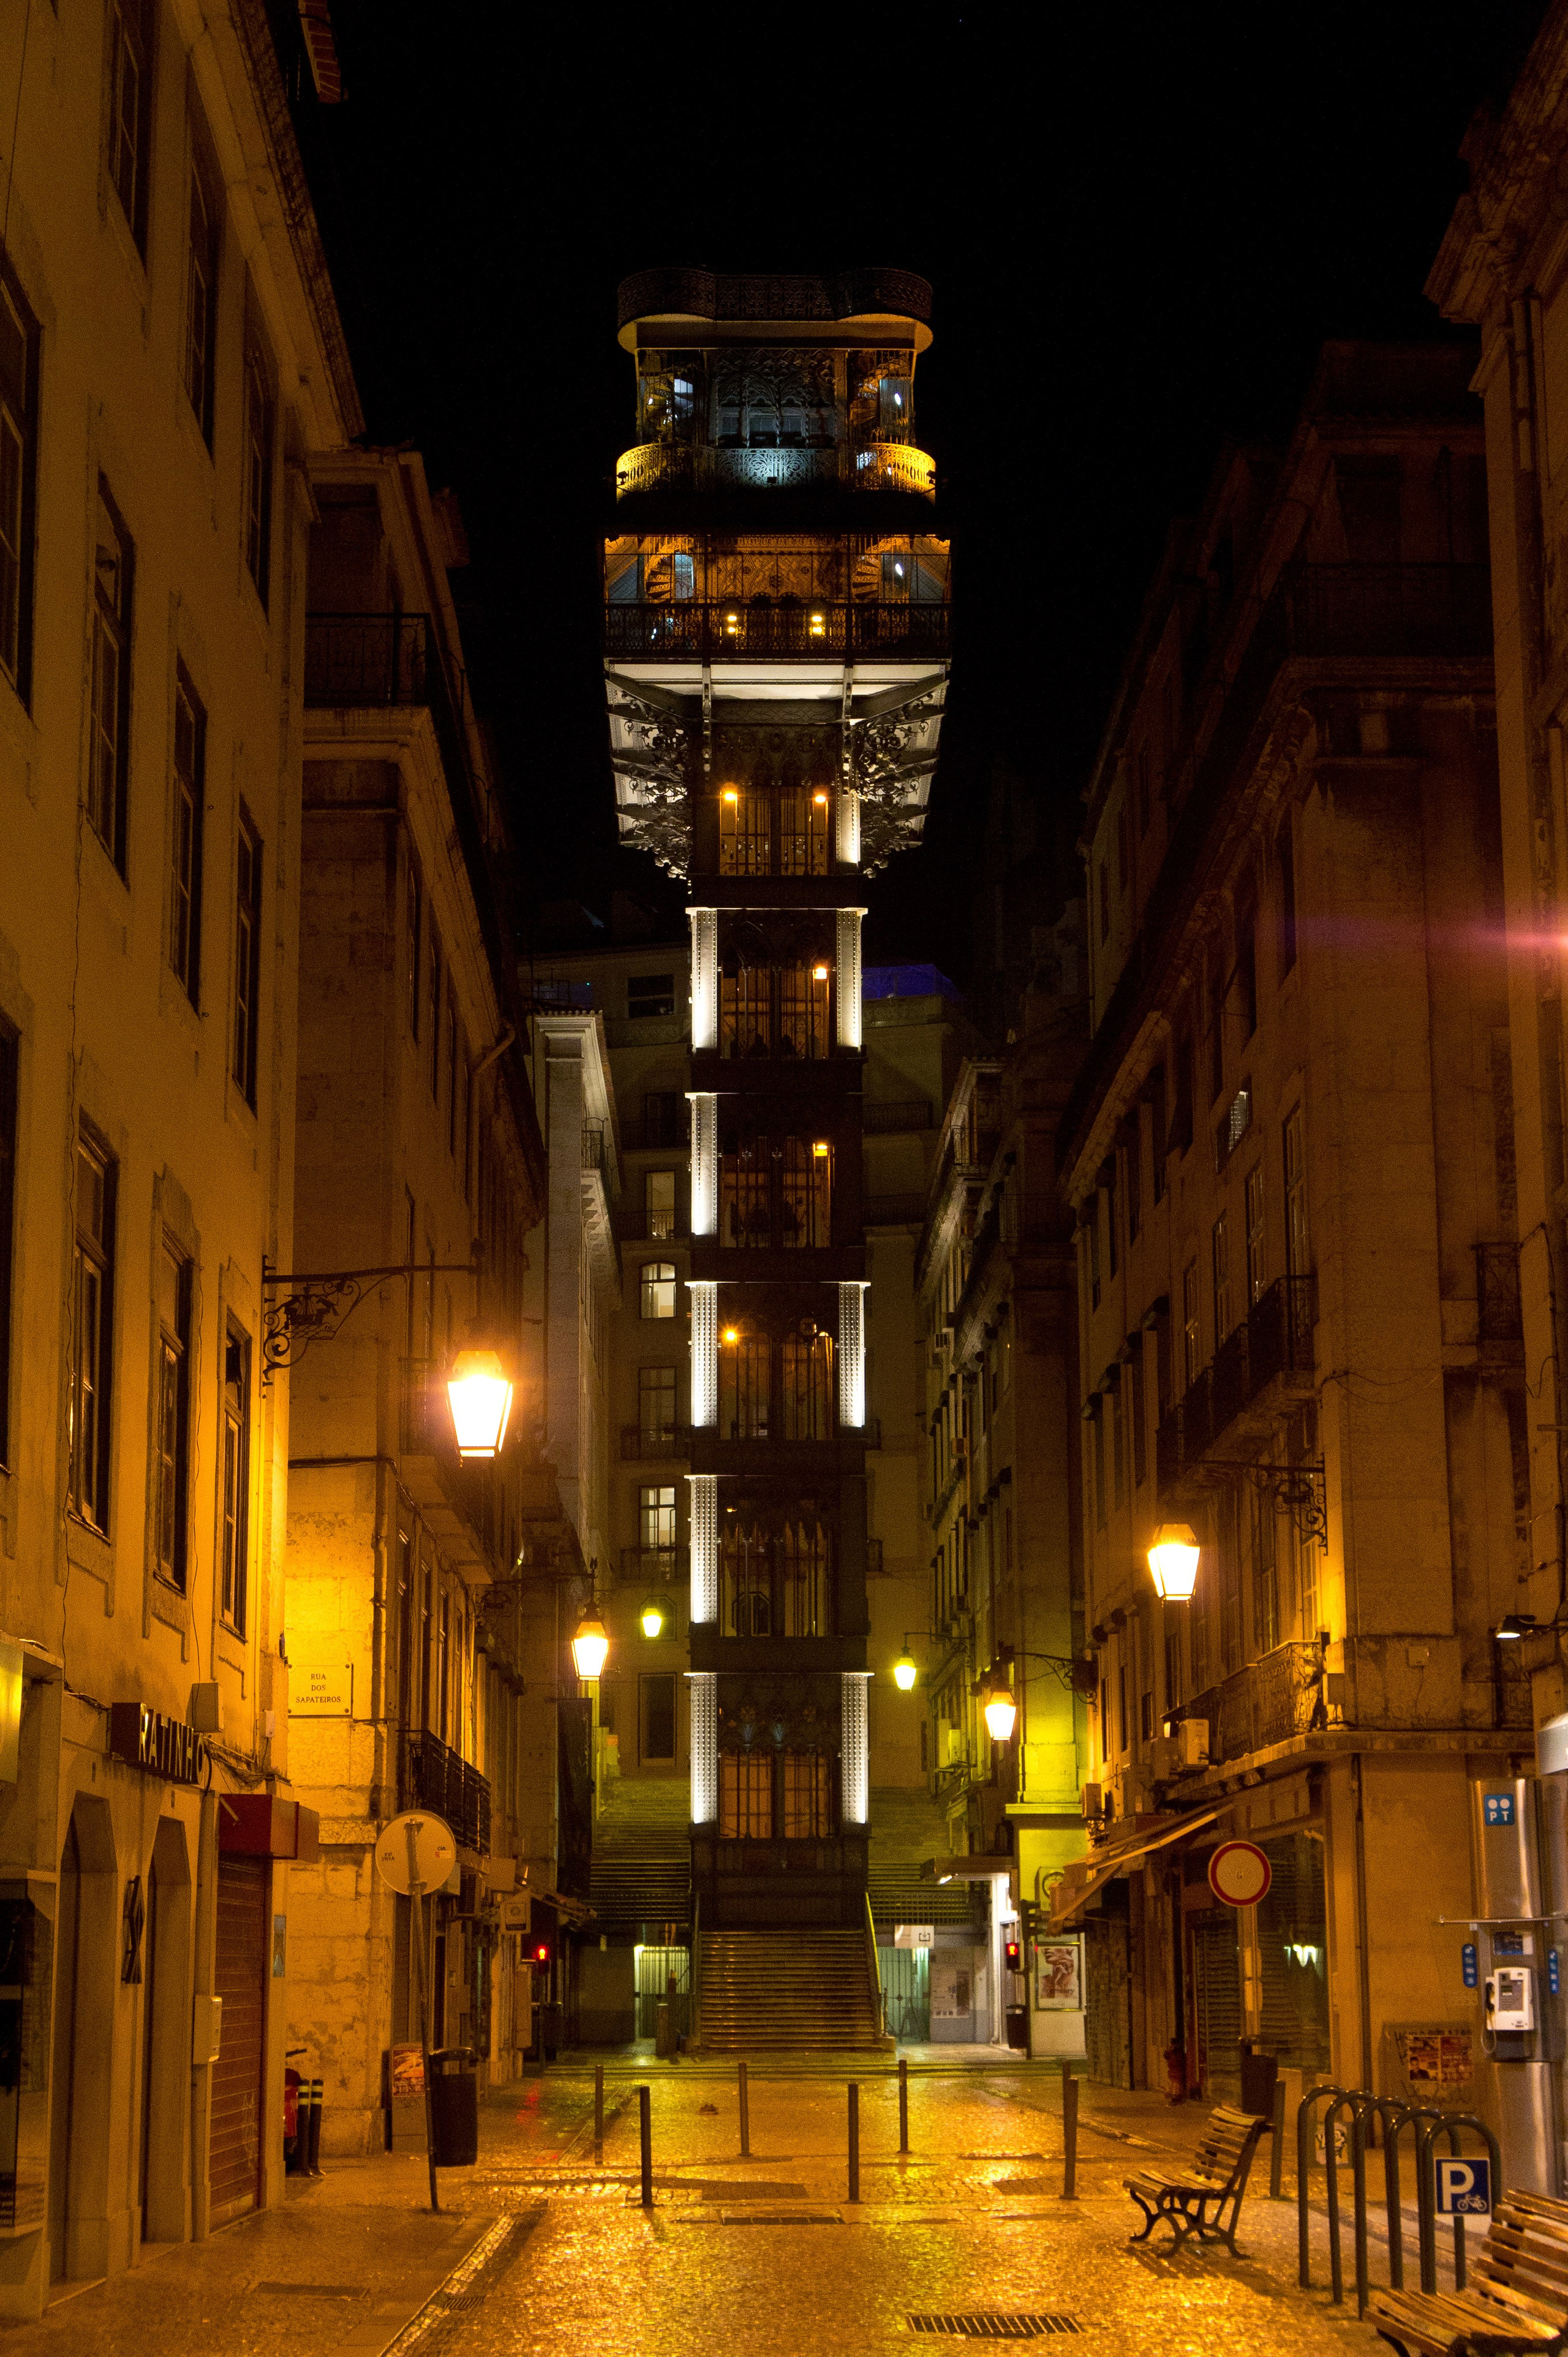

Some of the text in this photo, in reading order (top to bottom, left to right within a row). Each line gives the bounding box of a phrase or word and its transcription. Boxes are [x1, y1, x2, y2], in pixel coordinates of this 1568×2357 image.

[138, 1703, 205, 1787] RATINHO
[1489, 1810, 1510, 1822] PT
[1441, 2162, 1475, 2211] P
